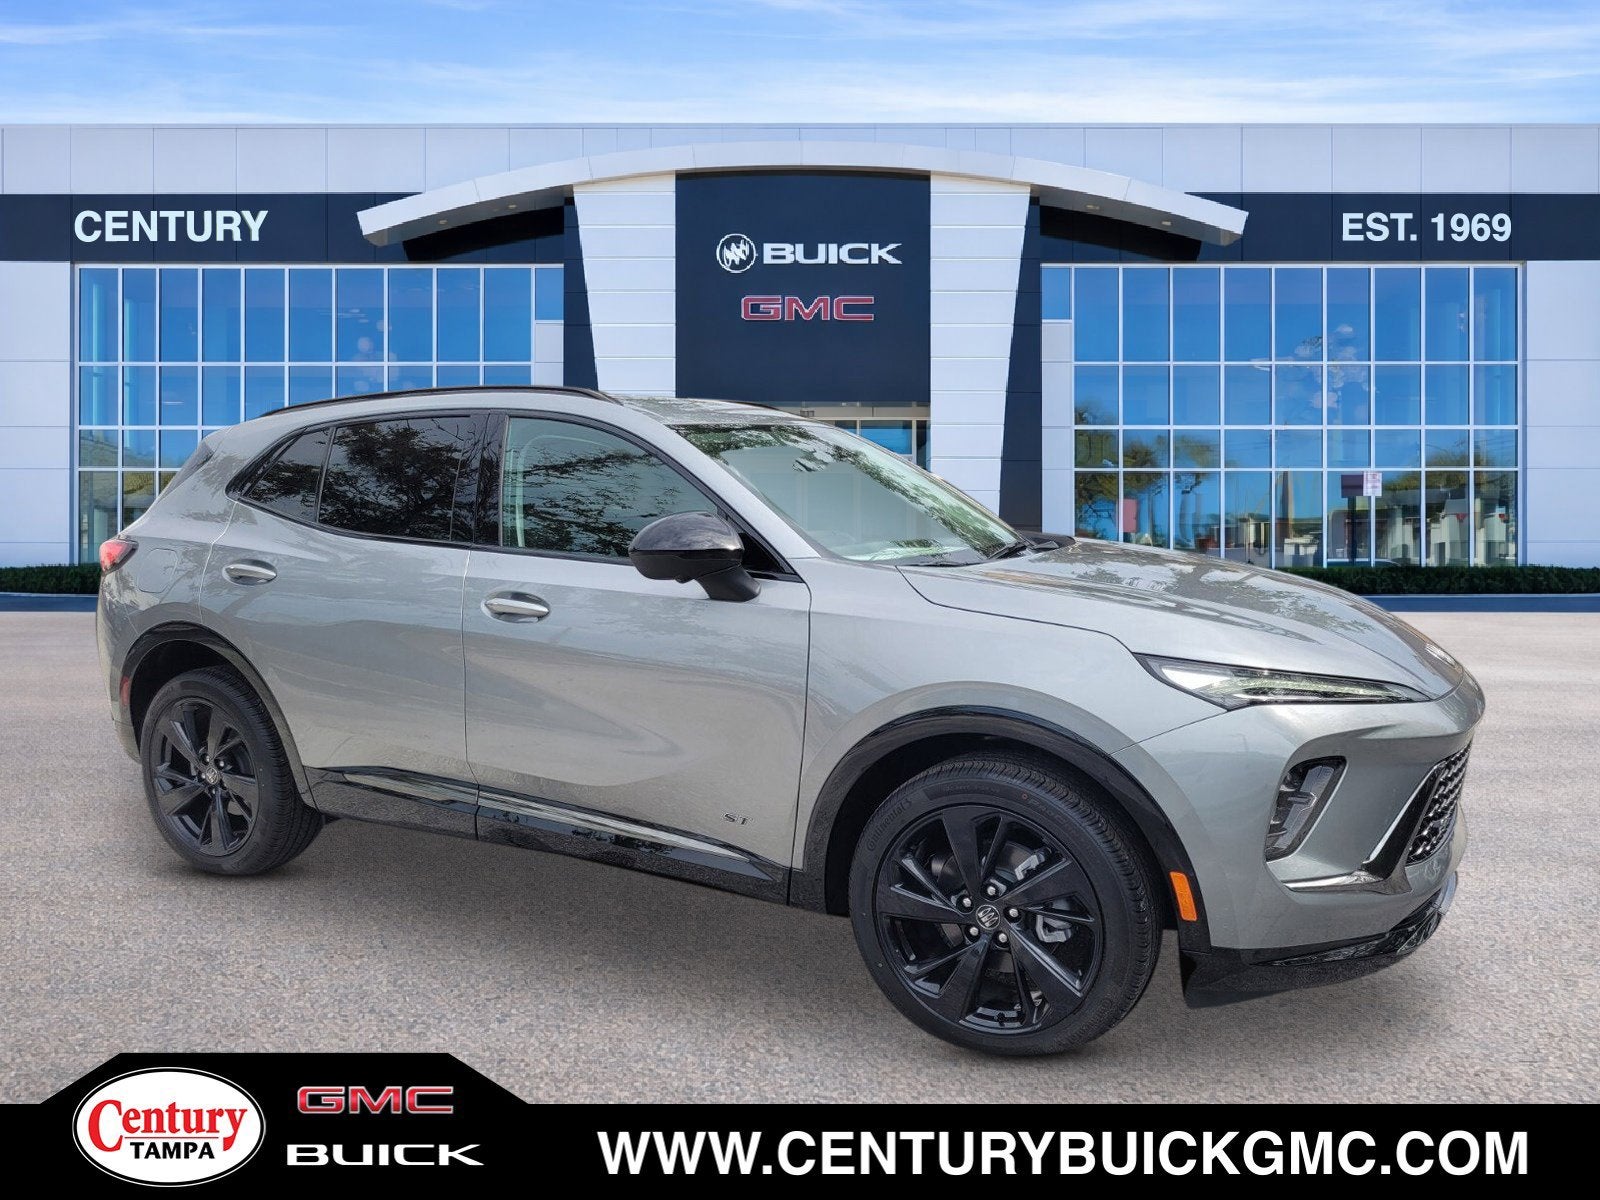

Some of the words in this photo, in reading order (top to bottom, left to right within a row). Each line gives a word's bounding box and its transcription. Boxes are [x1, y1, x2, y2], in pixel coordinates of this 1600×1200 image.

[75, 210, 268, 242] CENTURY
[1342, 212, 1417, 242] EST.
[1431, 212, 1512, 242] 1969
[763, 243, 902, 265] BUICK
[741, 295, 874, 321] GMC
[724, 813, 753, 825] ST
